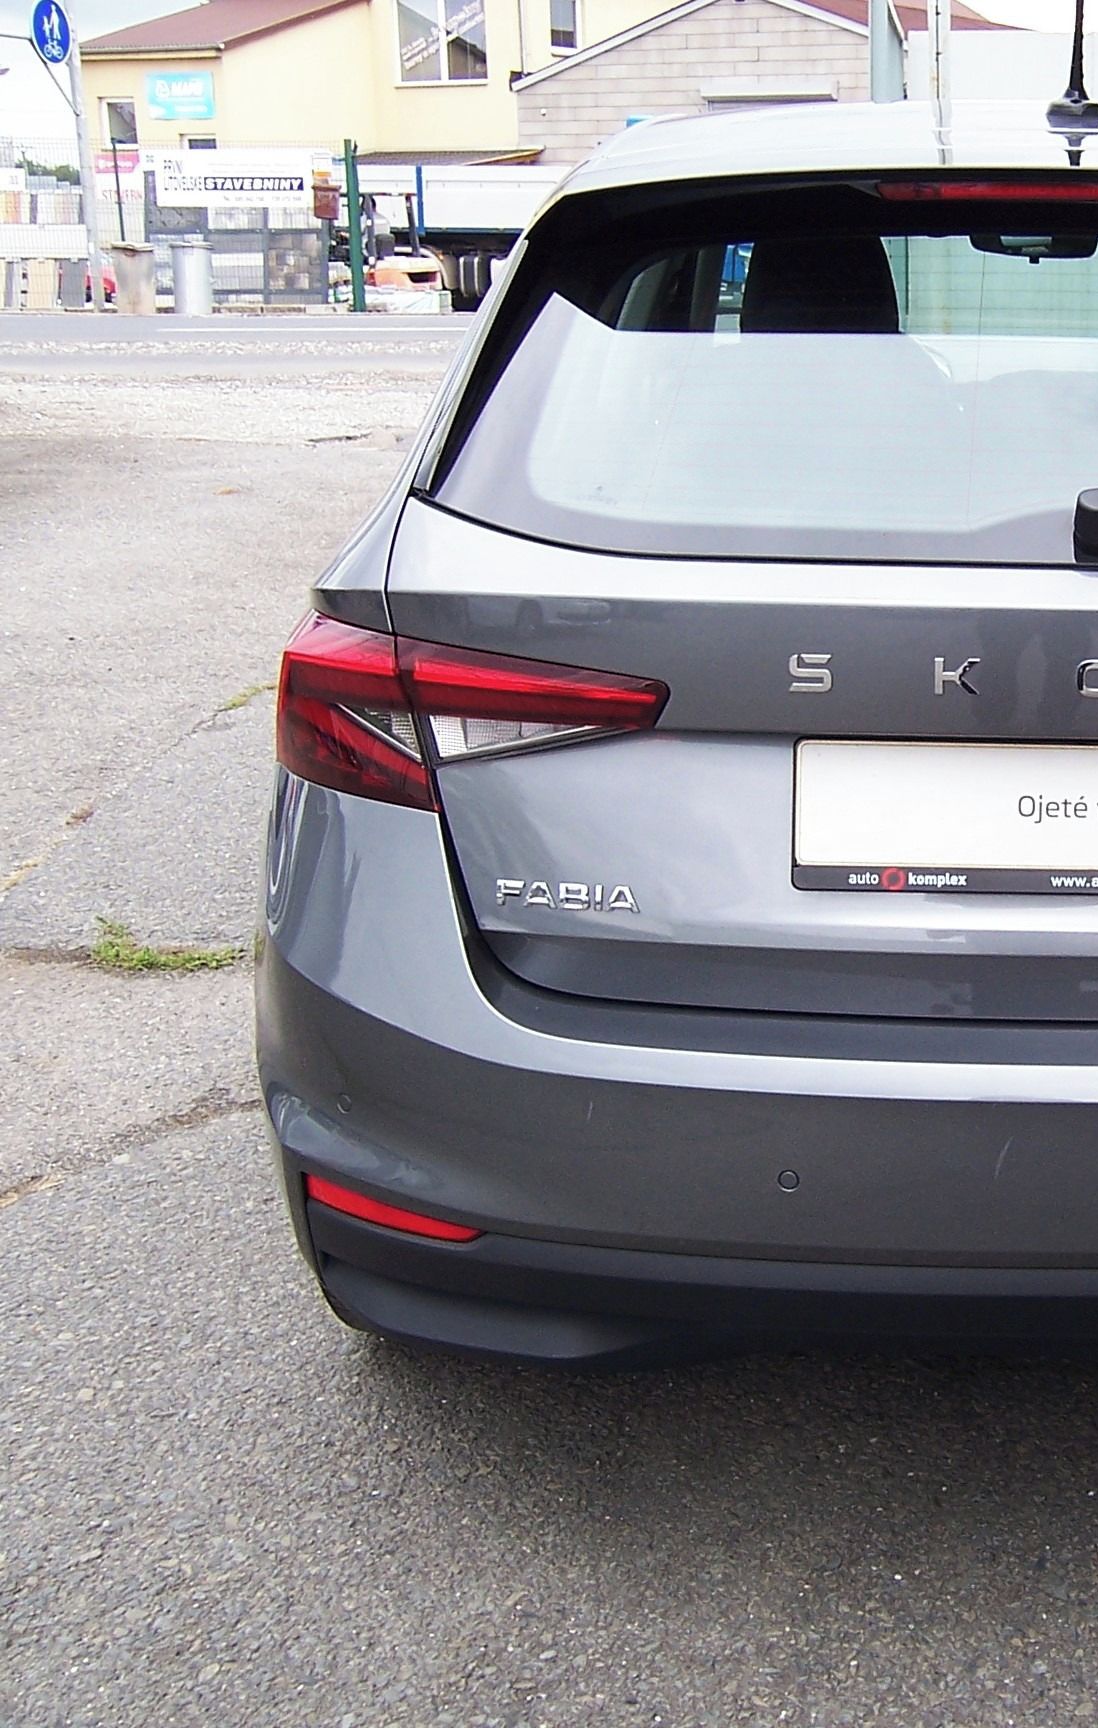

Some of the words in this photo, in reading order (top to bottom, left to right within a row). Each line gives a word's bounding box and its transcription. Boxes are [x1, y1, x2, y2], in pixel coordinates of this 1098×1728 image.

[205, 178, 302, 190] STAVEBNINY
[1017, 794, 1088, 824] Ojeté
[848, 872, 880, 885] auto
[907, 872, 968, 888] komplex
[496, 878, 640, 914] FABIA
